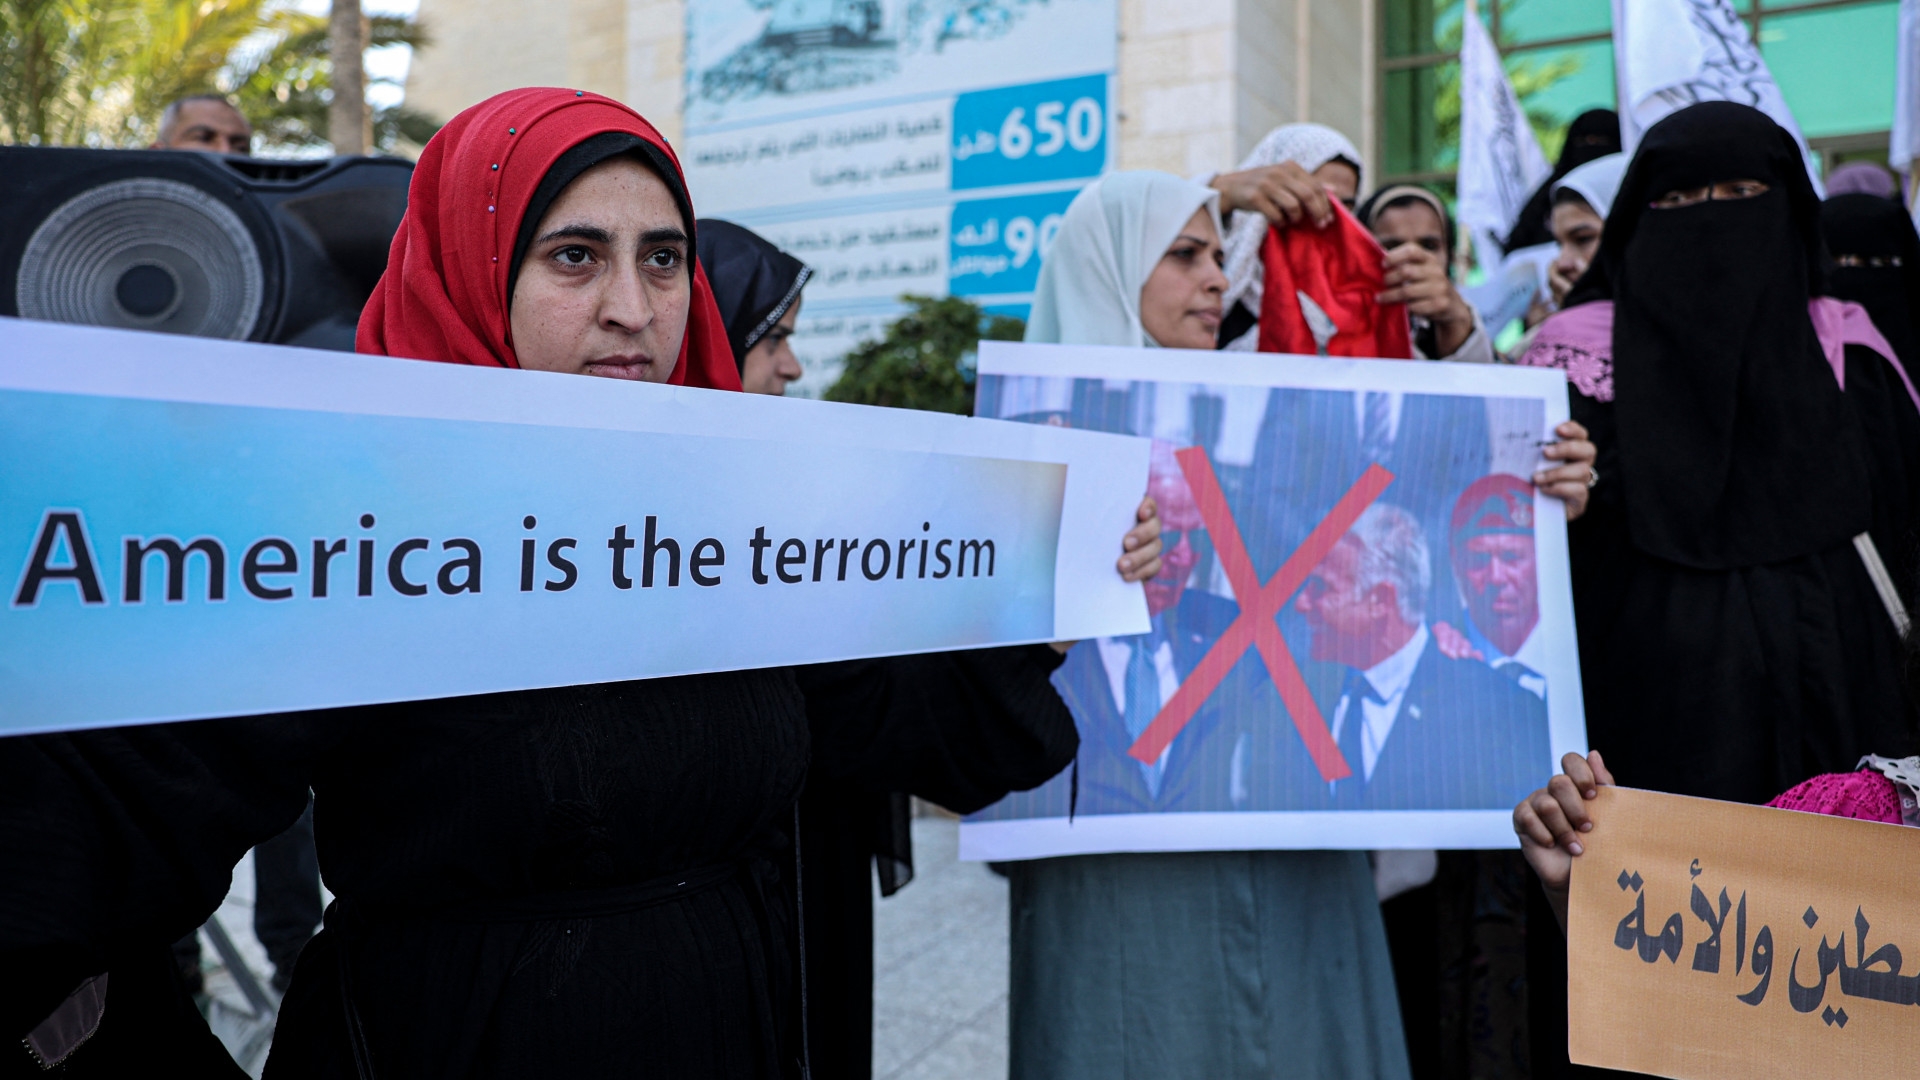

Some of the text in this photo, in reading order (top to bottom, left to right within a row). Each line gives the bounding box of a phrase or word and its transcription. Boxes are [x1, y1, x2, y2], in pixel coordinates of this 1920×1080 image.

[1000, 97, 1103, 159] 650
[14, 511, 995, 606] America is the terrorism
[1614, 858, 1920, 1029] طين والأمة
